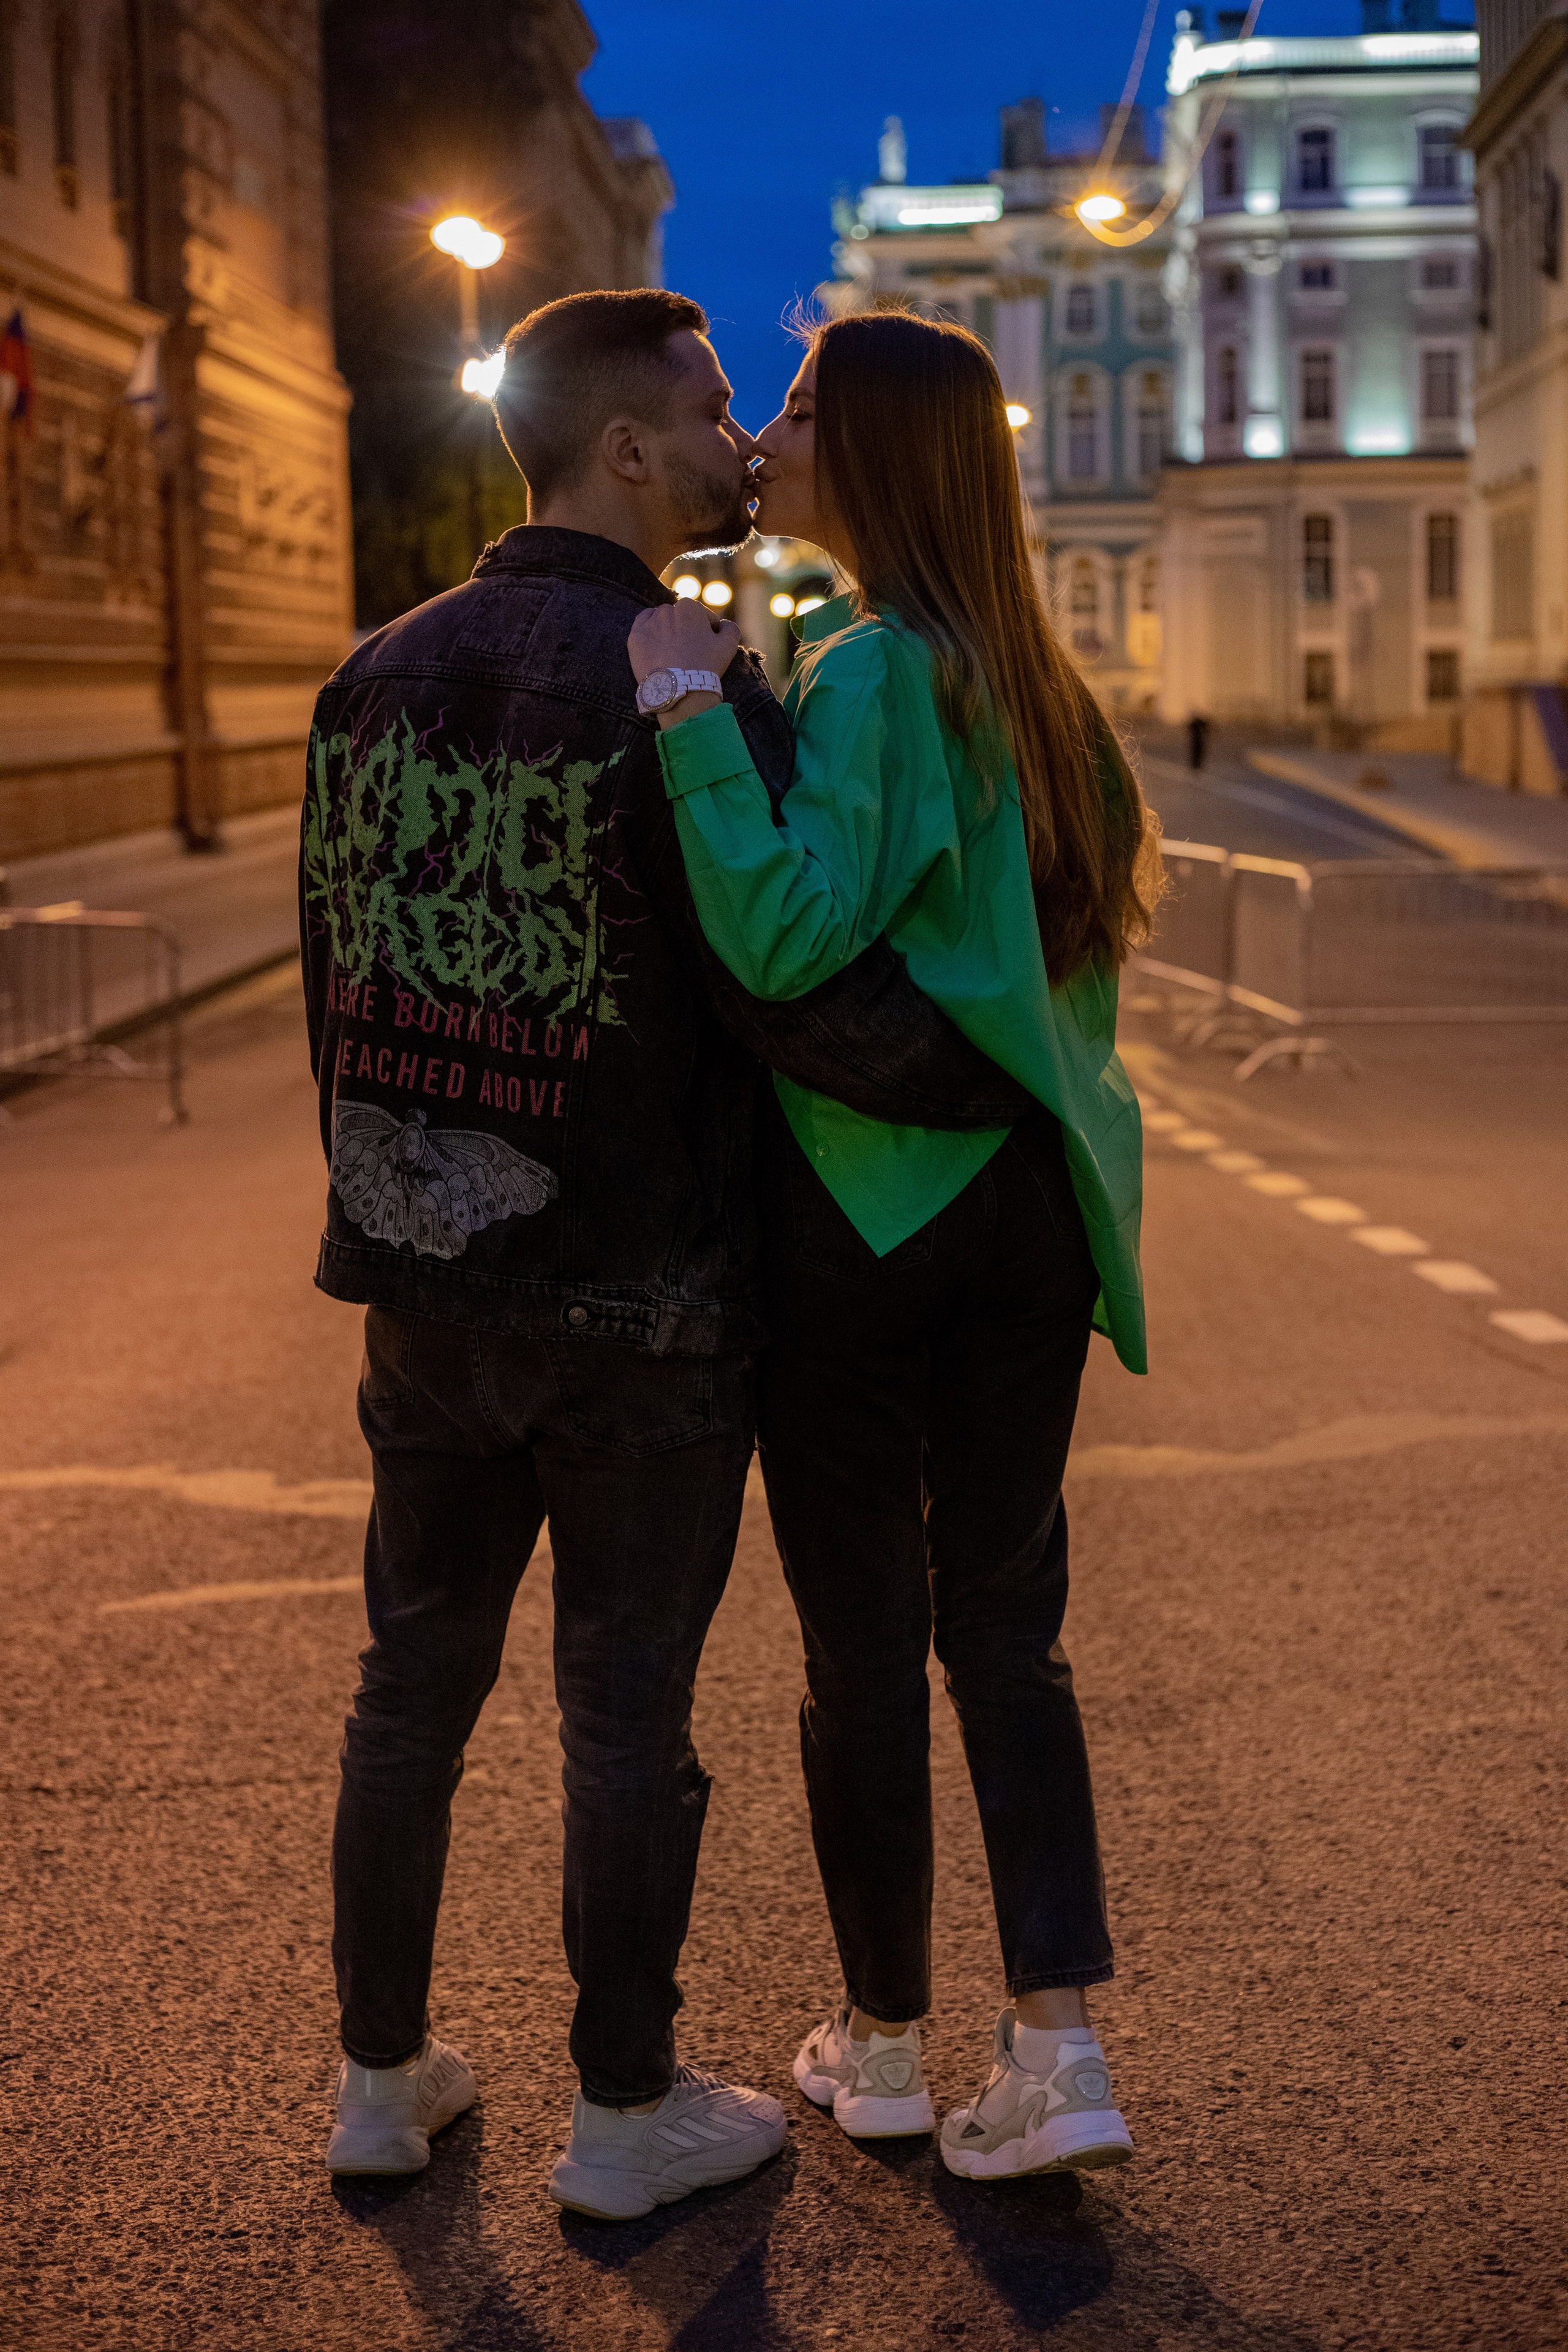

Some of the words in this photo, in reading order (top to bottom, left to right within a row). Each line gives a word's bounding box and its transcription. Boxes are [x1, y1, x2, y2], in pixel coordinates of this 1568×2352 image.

[394, 991, 481, 1043] BORN
[334, 1036, 466, 1099] EACHED
[478, 1068, 566, 1118] ABOVE
